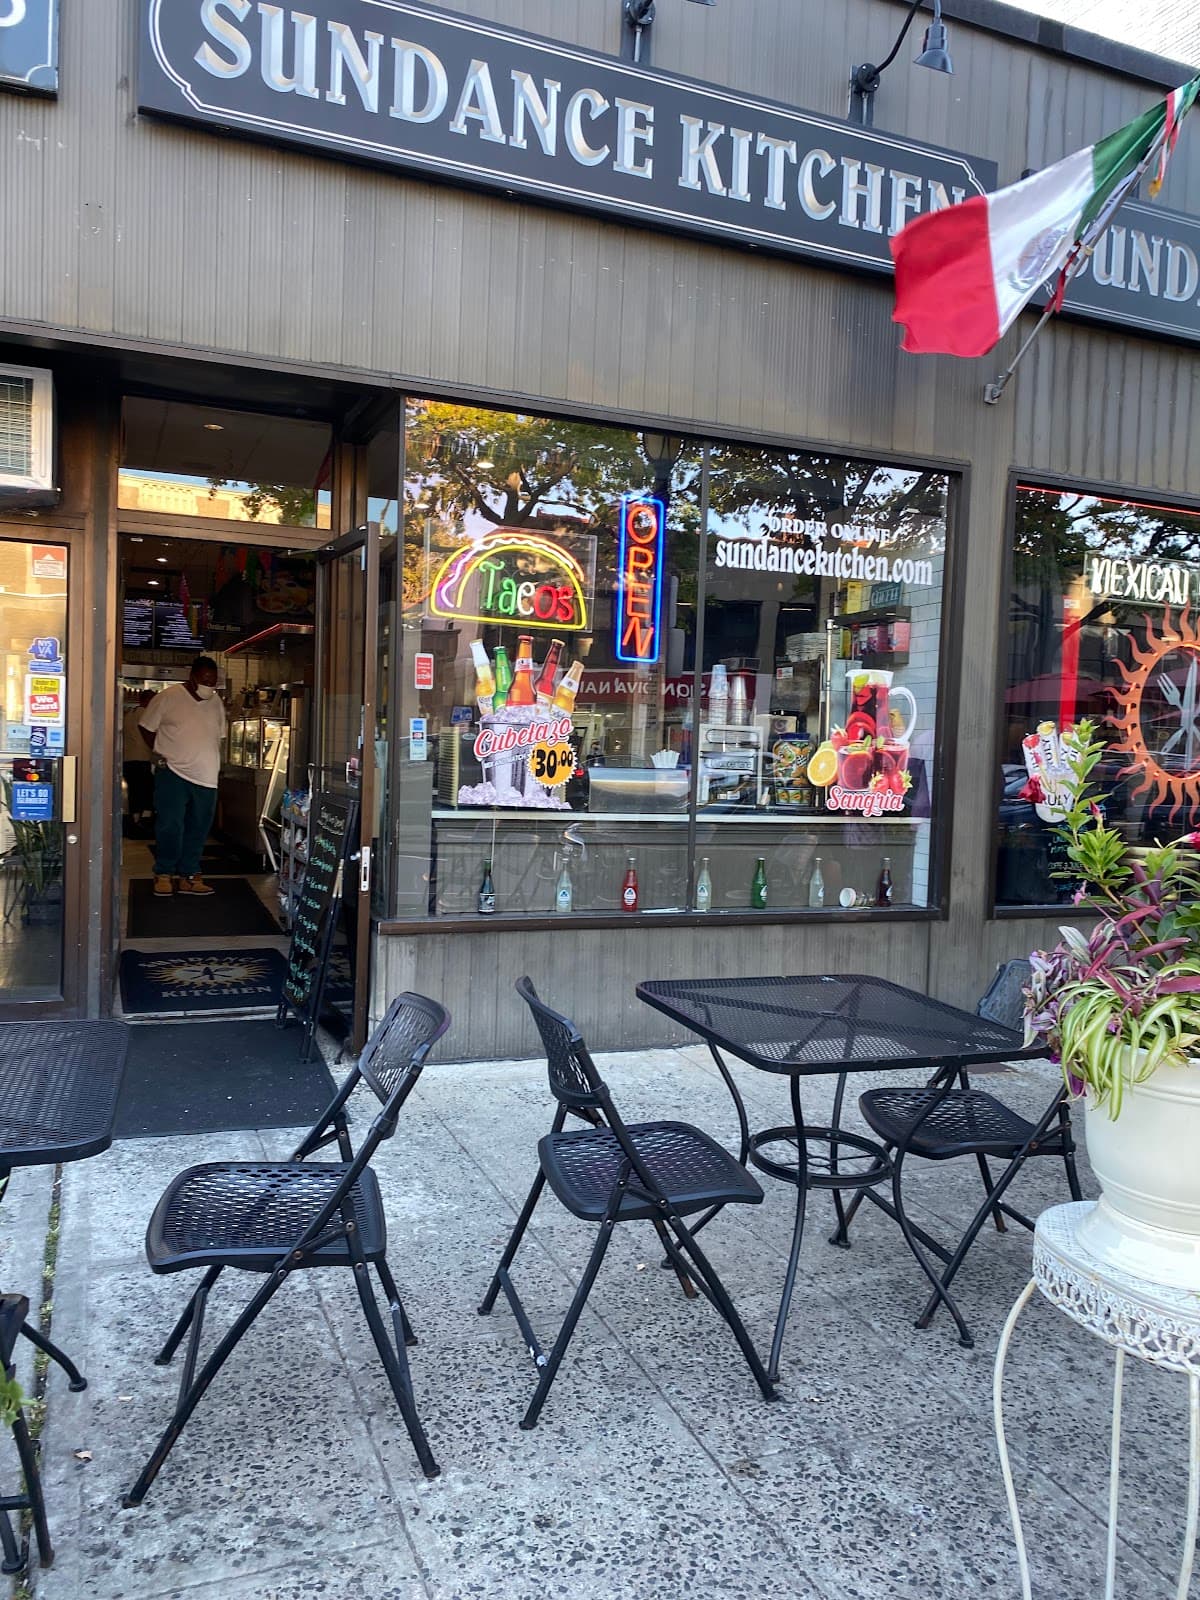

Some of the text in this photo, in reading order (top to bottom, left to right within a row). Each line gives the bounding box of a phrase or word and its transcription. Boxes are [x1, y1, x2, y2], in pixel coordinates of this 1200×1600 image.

[194, 0, 655, 180] SUNDANCE
[1064, 223, 1200, 306] UND
[768, 516, 893, 544] ORDER ONLINE
[622, 505, 658, 657] OPEN
[715, 536, 933, 586] sundancekitchen.com
[1091, 557, 1190, 605] MEXICAN
[479, 560, 574, 621] Tacos
[474, 718, 573, 757] Cubetazo
[16, 788, 36, 797] LET'S
[827, 786, 905, 816] Sangria
[161, 985, 272, 998] KITCHEN
